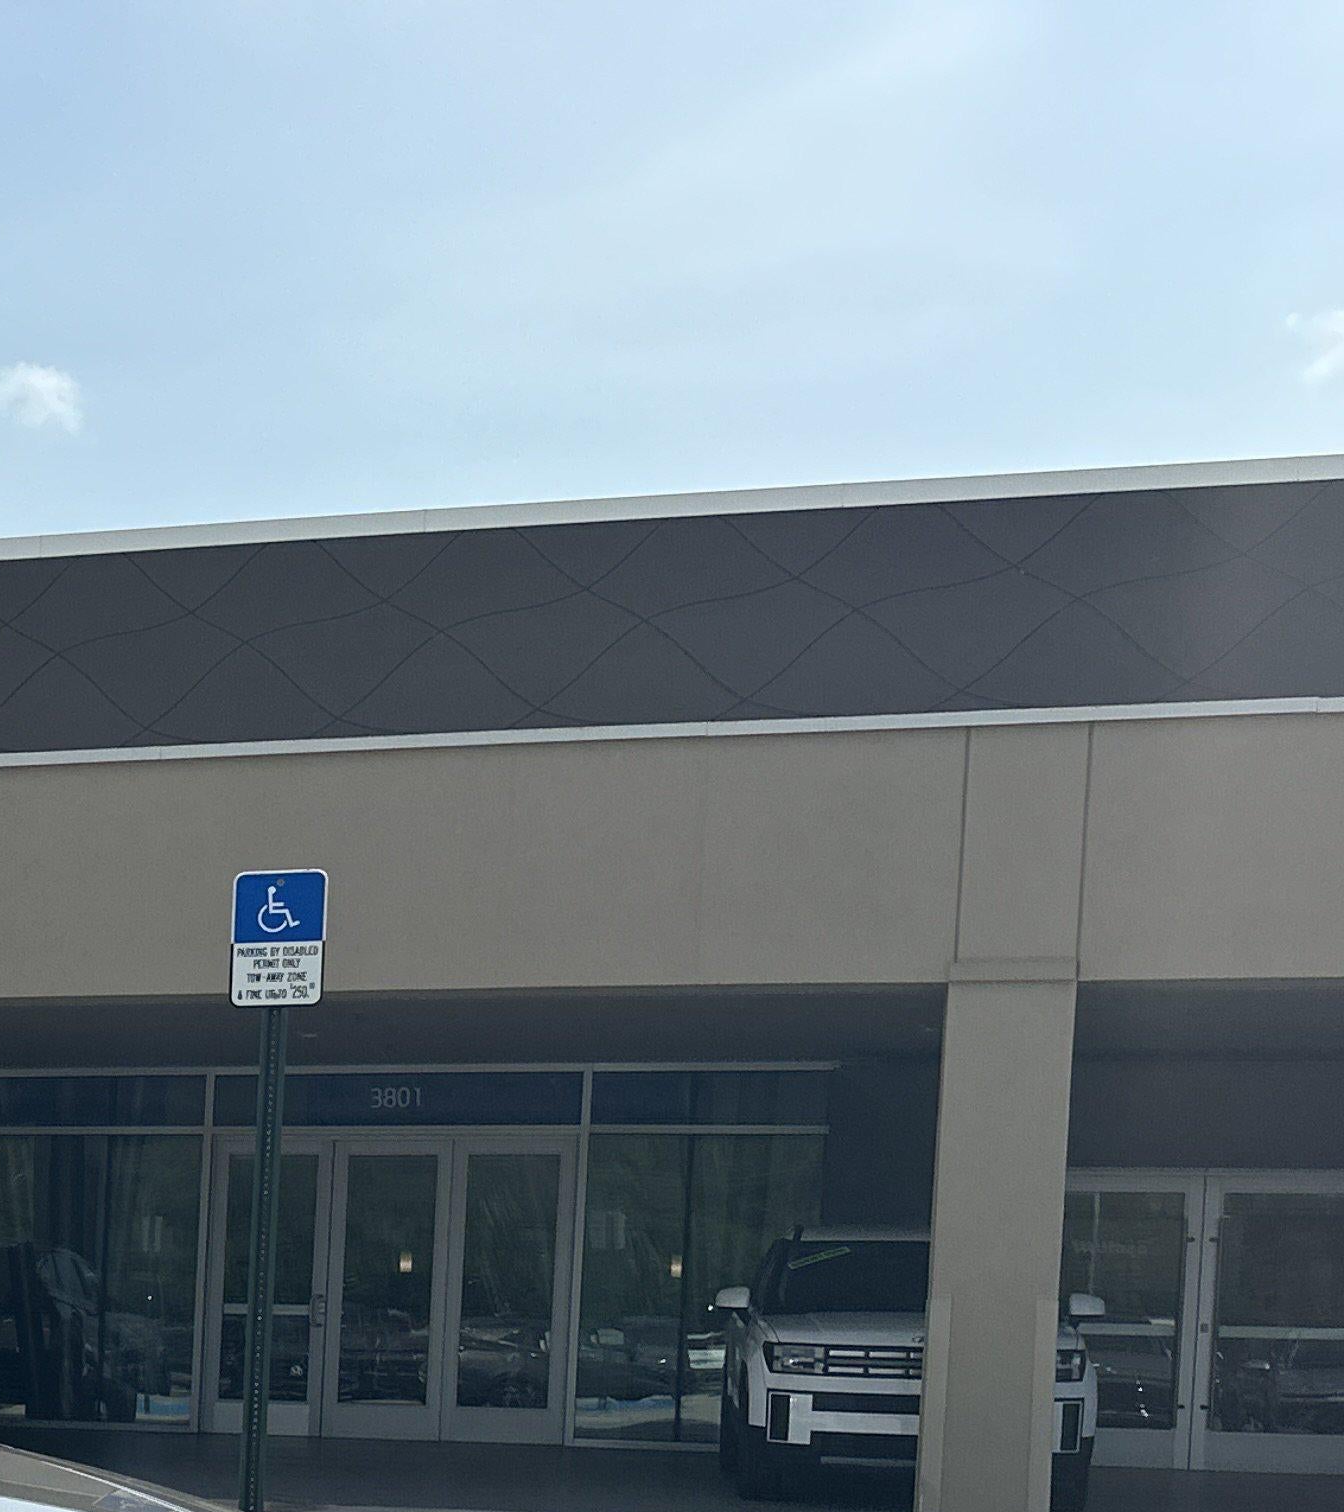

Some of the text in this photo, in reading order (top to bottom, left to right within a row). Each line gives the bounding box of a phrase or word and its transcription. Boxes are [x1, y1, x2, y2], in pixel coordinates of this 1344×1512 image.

[270, 946, 280, 957] BY
[282, 945, 319, 957] DISABLED
[287, 971, 308, 982] ZONE
[370, 1086, 422, 1109] 3801
